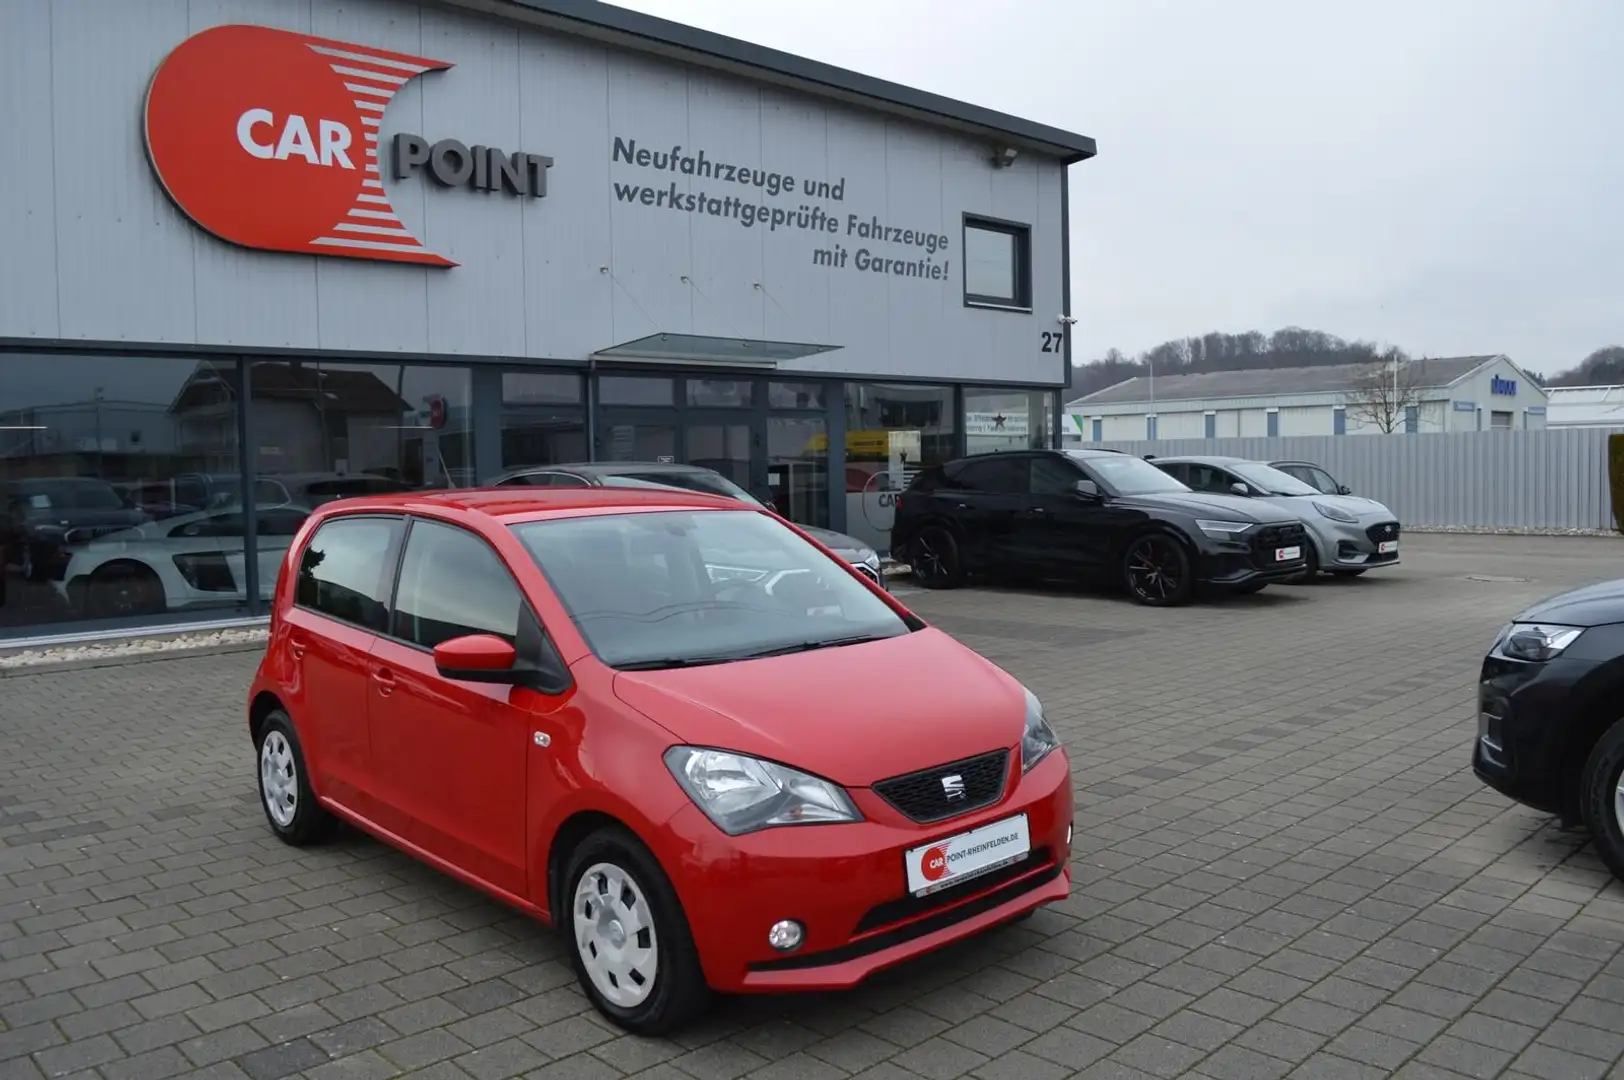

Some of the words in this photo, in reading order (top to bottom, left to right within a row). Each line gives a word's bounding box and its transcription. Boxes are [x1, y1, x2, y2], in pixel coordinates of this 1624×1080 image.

[236, 108, 356, 170] CAR
[393, 133, 553, 197] POINT
[612, 136, 795, 196] Neufahrzeuge
[803, 177, 845, 200] und
[613, 182, 839, 233] werkstattgeprüfte
[846, 214, 949, 254] Fahrzeuge
[812, 244, 848, 267] mit
[854, 248, 949, 280] Garantie!
[1041, 331, 1063, 353] 27
[929, 857, 944, 868] CAR
[946, 832, 1019, 863] POINT-RHEINFELDEN.DE
